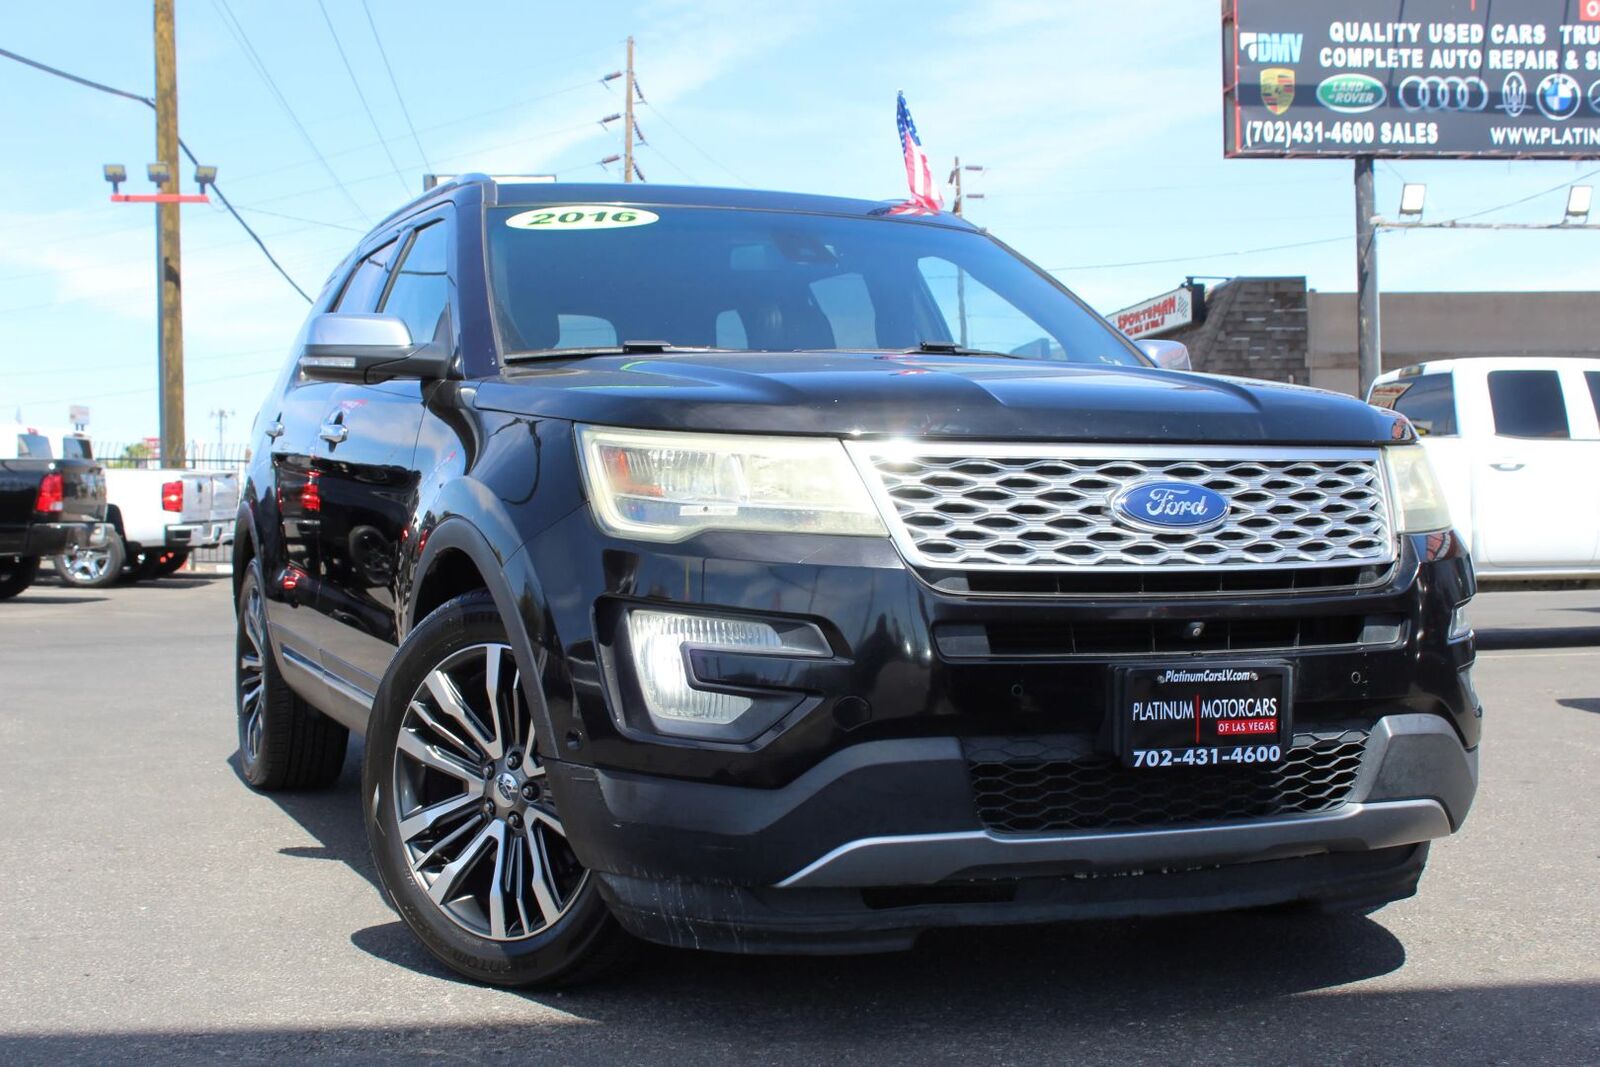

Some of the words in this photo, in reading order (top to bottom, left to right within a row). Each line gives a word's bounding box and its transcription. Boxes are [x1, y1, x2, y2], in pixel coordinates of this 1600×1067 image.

[1330, 22, 1422, 43] QUALITY
[1429, 24, 1484, 44] USED
[1491, 24, 1546, 45] CARS
[1559, 25, 1600, 45] TRU
[1258, 33, 1303, 63] DMV
[1320, 48, 1424, 67] COMPLETE
[1430, 49, 1482, 68] AUTO
[1489, 50, 1558, 69] REPAIR
[1565, 50, 1579, 70] &
[1585, 50, 1600, 70] S
[1332, 81, 1364, 92] LAND
[1335, 92, 1374, 104] ROVER
[1245, 120, 1374, 148] (702)431-4600
[1381, 123, 1439, 144] SALES
[1490, 127, 1600, 145] WWW.PLATIN
[526, 211, 637, 225] 2016
[1146, 488, 1208, 516] Ford
[1165, 669, 1250, 683] PlatinumCarsLV.com
[1133, 701, 1194, 721] PLATINUM
[1201, 697, 1277, 718] MOTORCARS
[1218, 723, 1229, 732] OF
[1232, 722, 1246, 732] LAS
[1249, 721, 1274, 731] VEGAS
[1133, 746, 1281, 767] 702-431-4600
